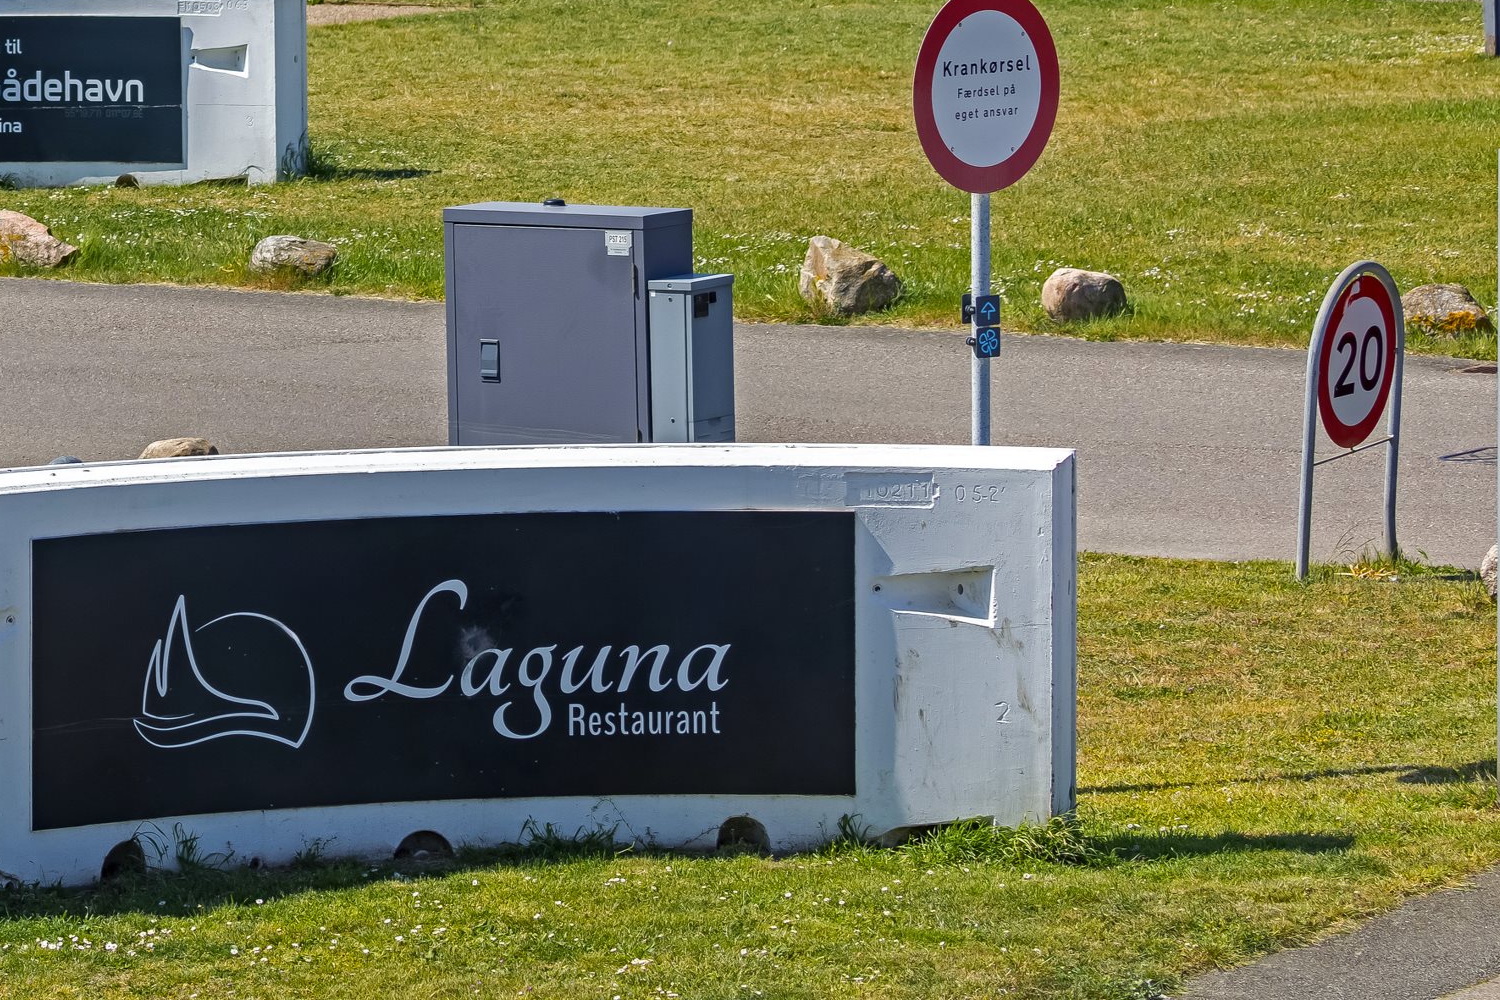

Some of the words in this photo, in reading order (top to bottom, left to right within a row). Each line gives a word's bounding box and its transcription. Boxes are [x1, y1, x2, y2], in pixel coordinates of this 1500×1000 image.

[5, 38, 22, 54] til
[943, 55, 1031, 77] Krankørsel
[957, 85, 999, 99] Færdsel
[1003, 84, 1016, 97] på
[955, 108, 978, 121] eget
[983, 107, 1018, 118] ansvar
[1333, 325, 1383, 398] 20
[343, 579, 731, 740] Laguna
[568, 701, 721, 736] Restaurant
